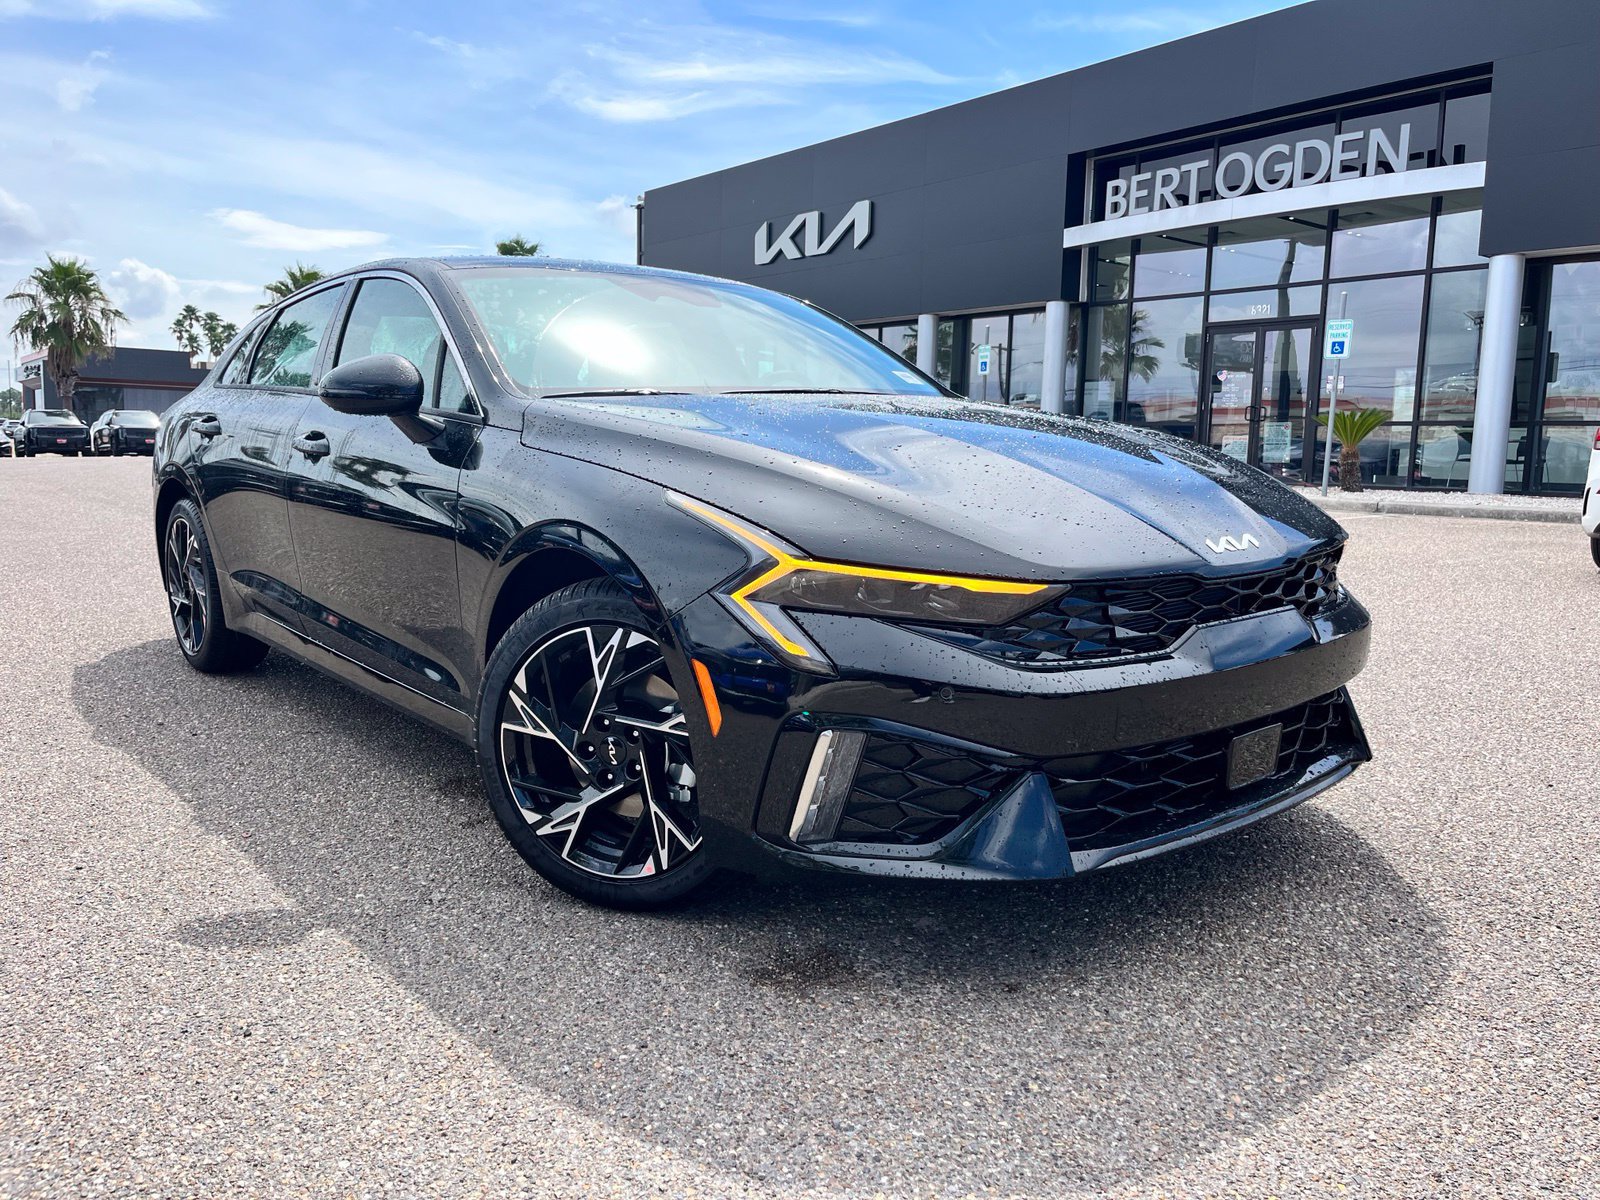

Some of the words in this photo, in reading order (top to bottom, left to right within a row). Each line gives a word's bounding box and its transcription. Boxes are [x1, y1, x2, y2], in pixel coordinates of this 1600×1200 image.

[1105, 159, 1209, 220] BERT
[1215, 123, 1411, 199] OGDEN
[754, 199, 873, 266] KIA
[1205, 533, 1260, 554] KIA
